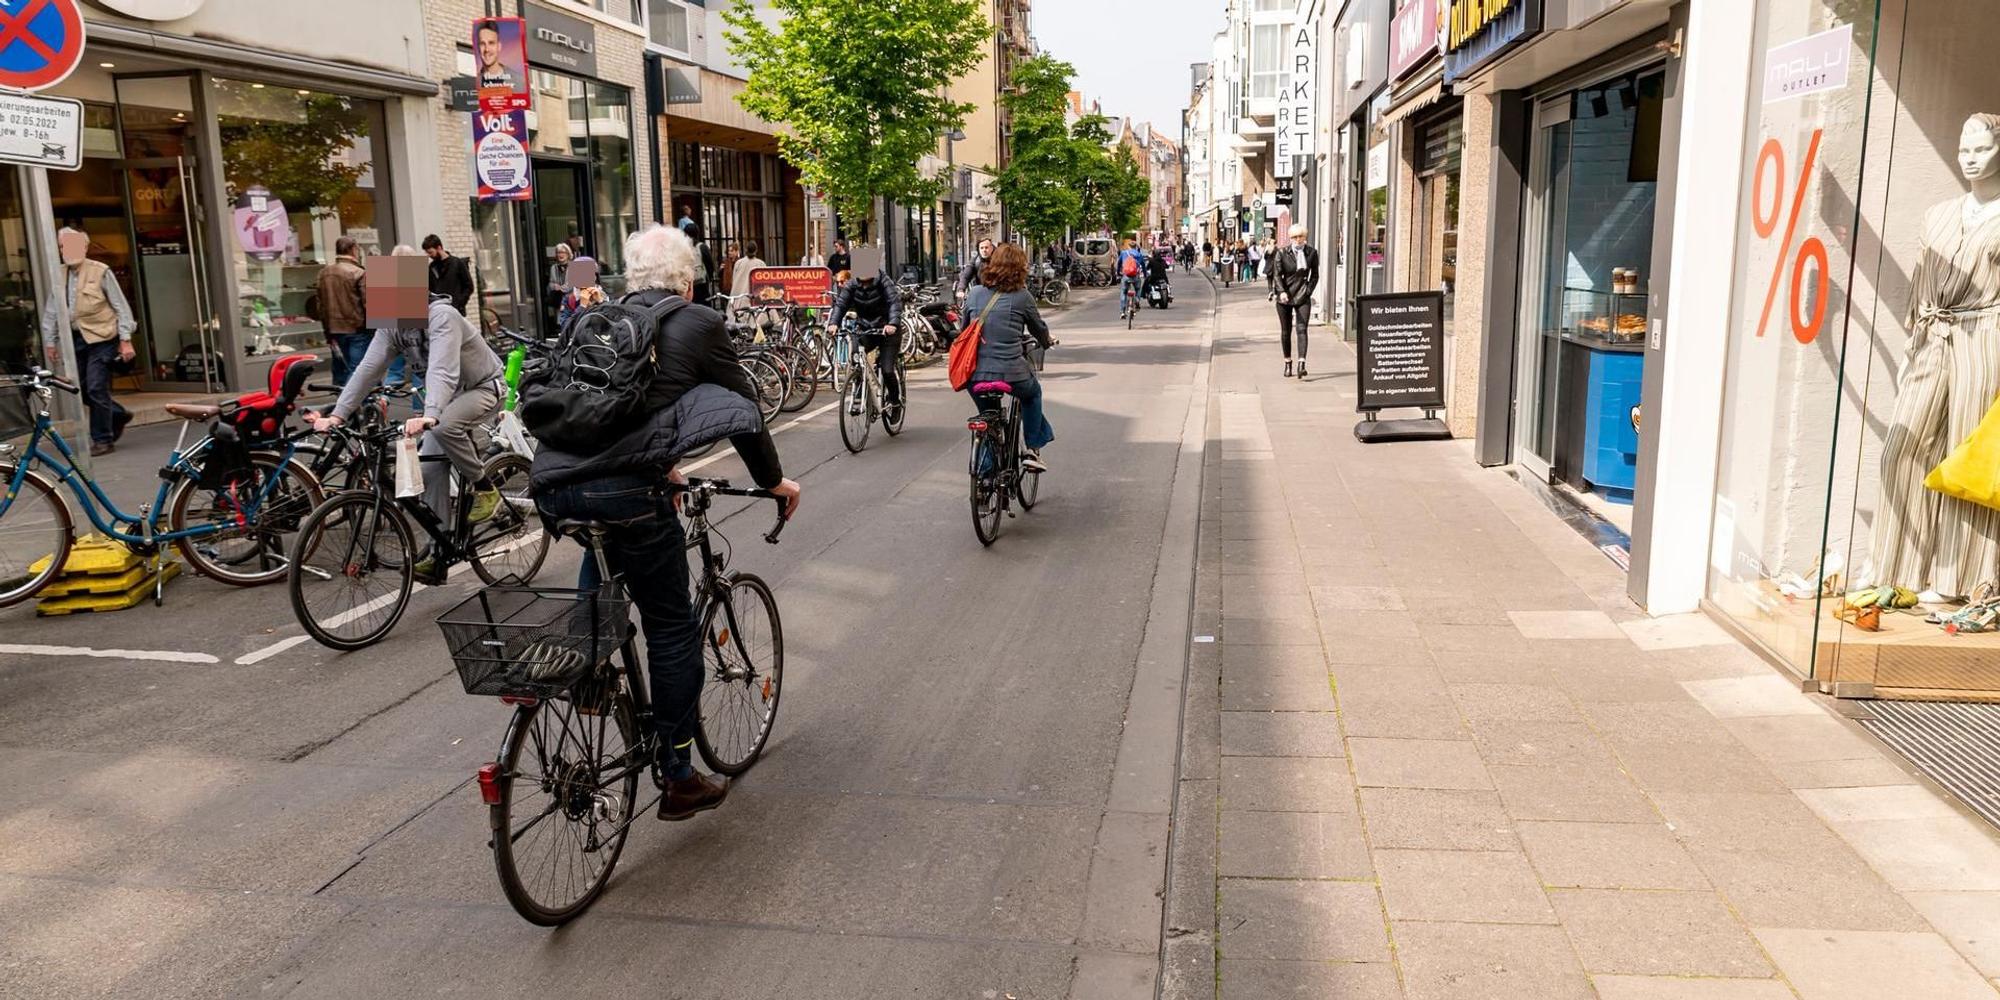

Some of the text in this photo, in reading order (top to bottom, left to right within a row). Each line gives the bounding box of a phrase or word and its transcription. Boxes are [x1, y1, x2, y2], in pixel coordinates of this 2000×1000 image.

[1783, 74, 1826, 92] OUTLET
[1294, 28, 1311, 151] ARKET
[10, 114, 57, 129] 02.05.2022
[480, 114, 515, 132] Volt
[23, 128, 49, 140] 8-16h
[1278, 89, 1290, 175] ARKET
[754, 271, 826, 281] GOLDANKAUF
[1384, 306, 1407, 314] bieten
[1368, 323, 1432, 331] Goldschmiedearbeiten
[1377, 358, 1423, 366] Batteriewechsel
[1406, 372, 1428, 380] Altgold
